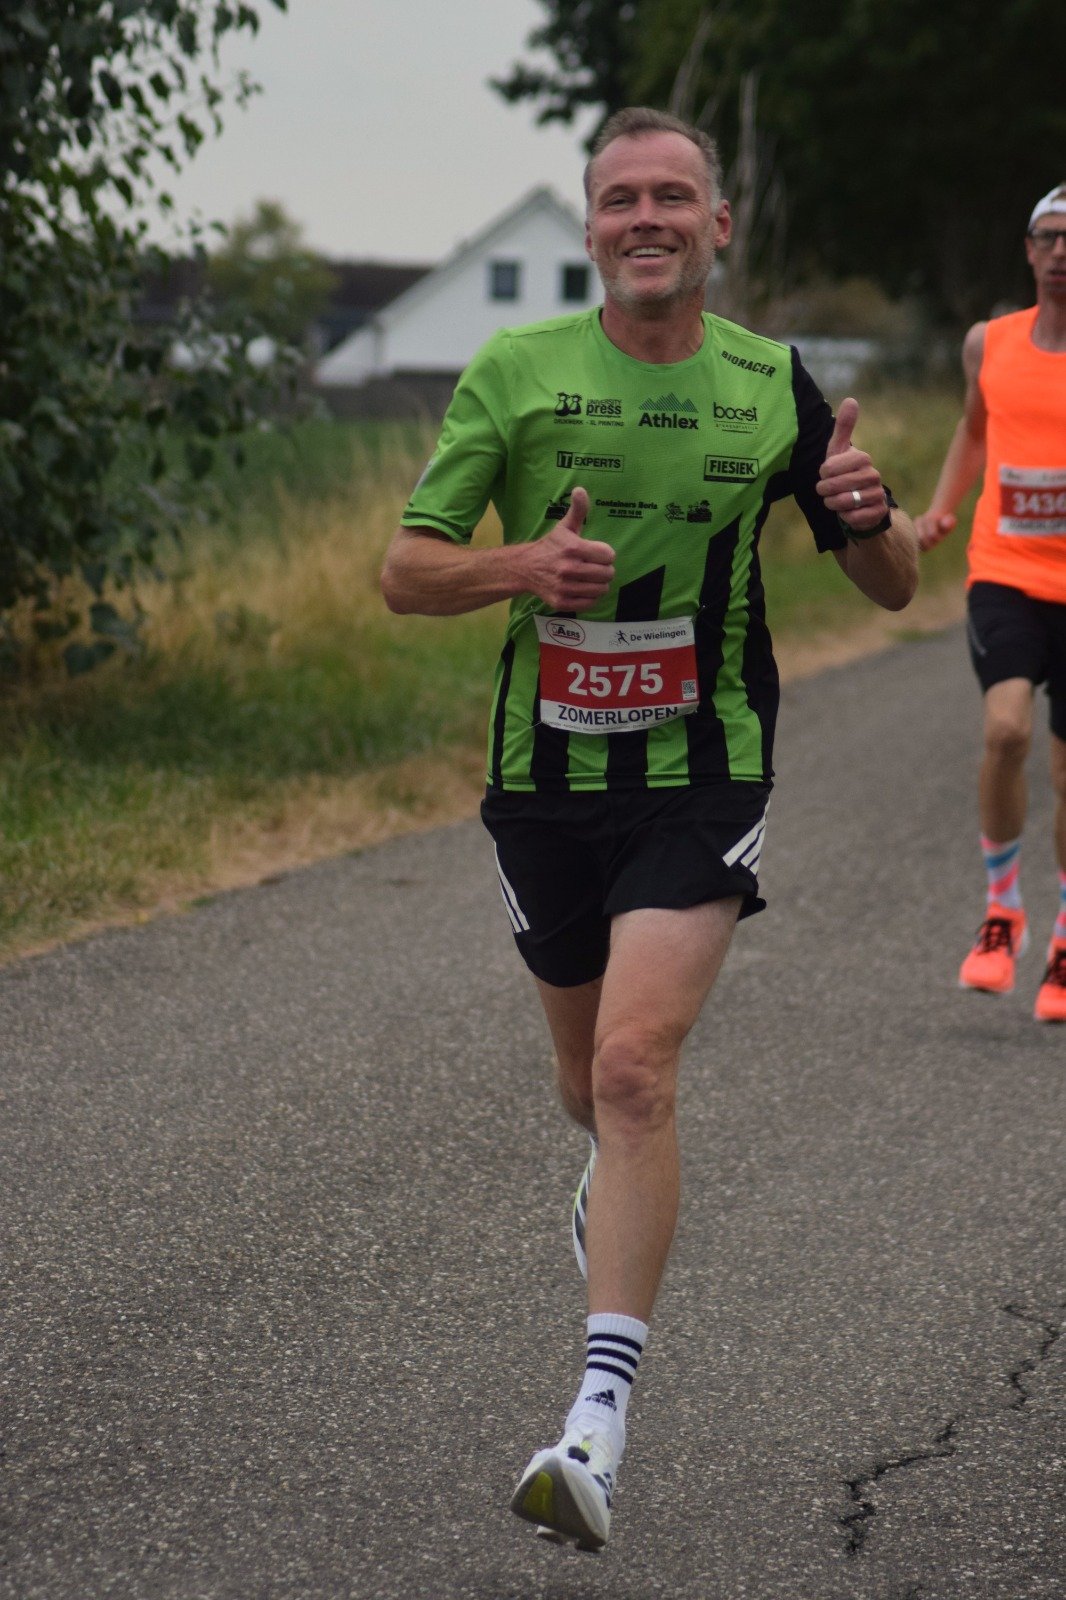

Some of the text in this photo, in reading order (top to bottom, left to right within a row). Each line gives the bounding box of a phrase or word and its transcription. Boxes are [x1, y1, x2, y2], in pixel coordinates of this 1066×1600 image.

[721, 350, 777, 378] BIORACER
[586, 404, 622, 416] press
[638, 412, 699, 430] Athlex
[558, 452, 621, 469] IT EXPERTS
[710, 459, 756, 475] FIESIEK
[595, 499, 637, 508] Containers
[630, 634, 642, 642] De
[644, 629, 686, 641] Wielingen
[566, 662, 664, 698] 2575
[558, 704, 678, 726] ZOMERLOPEN
